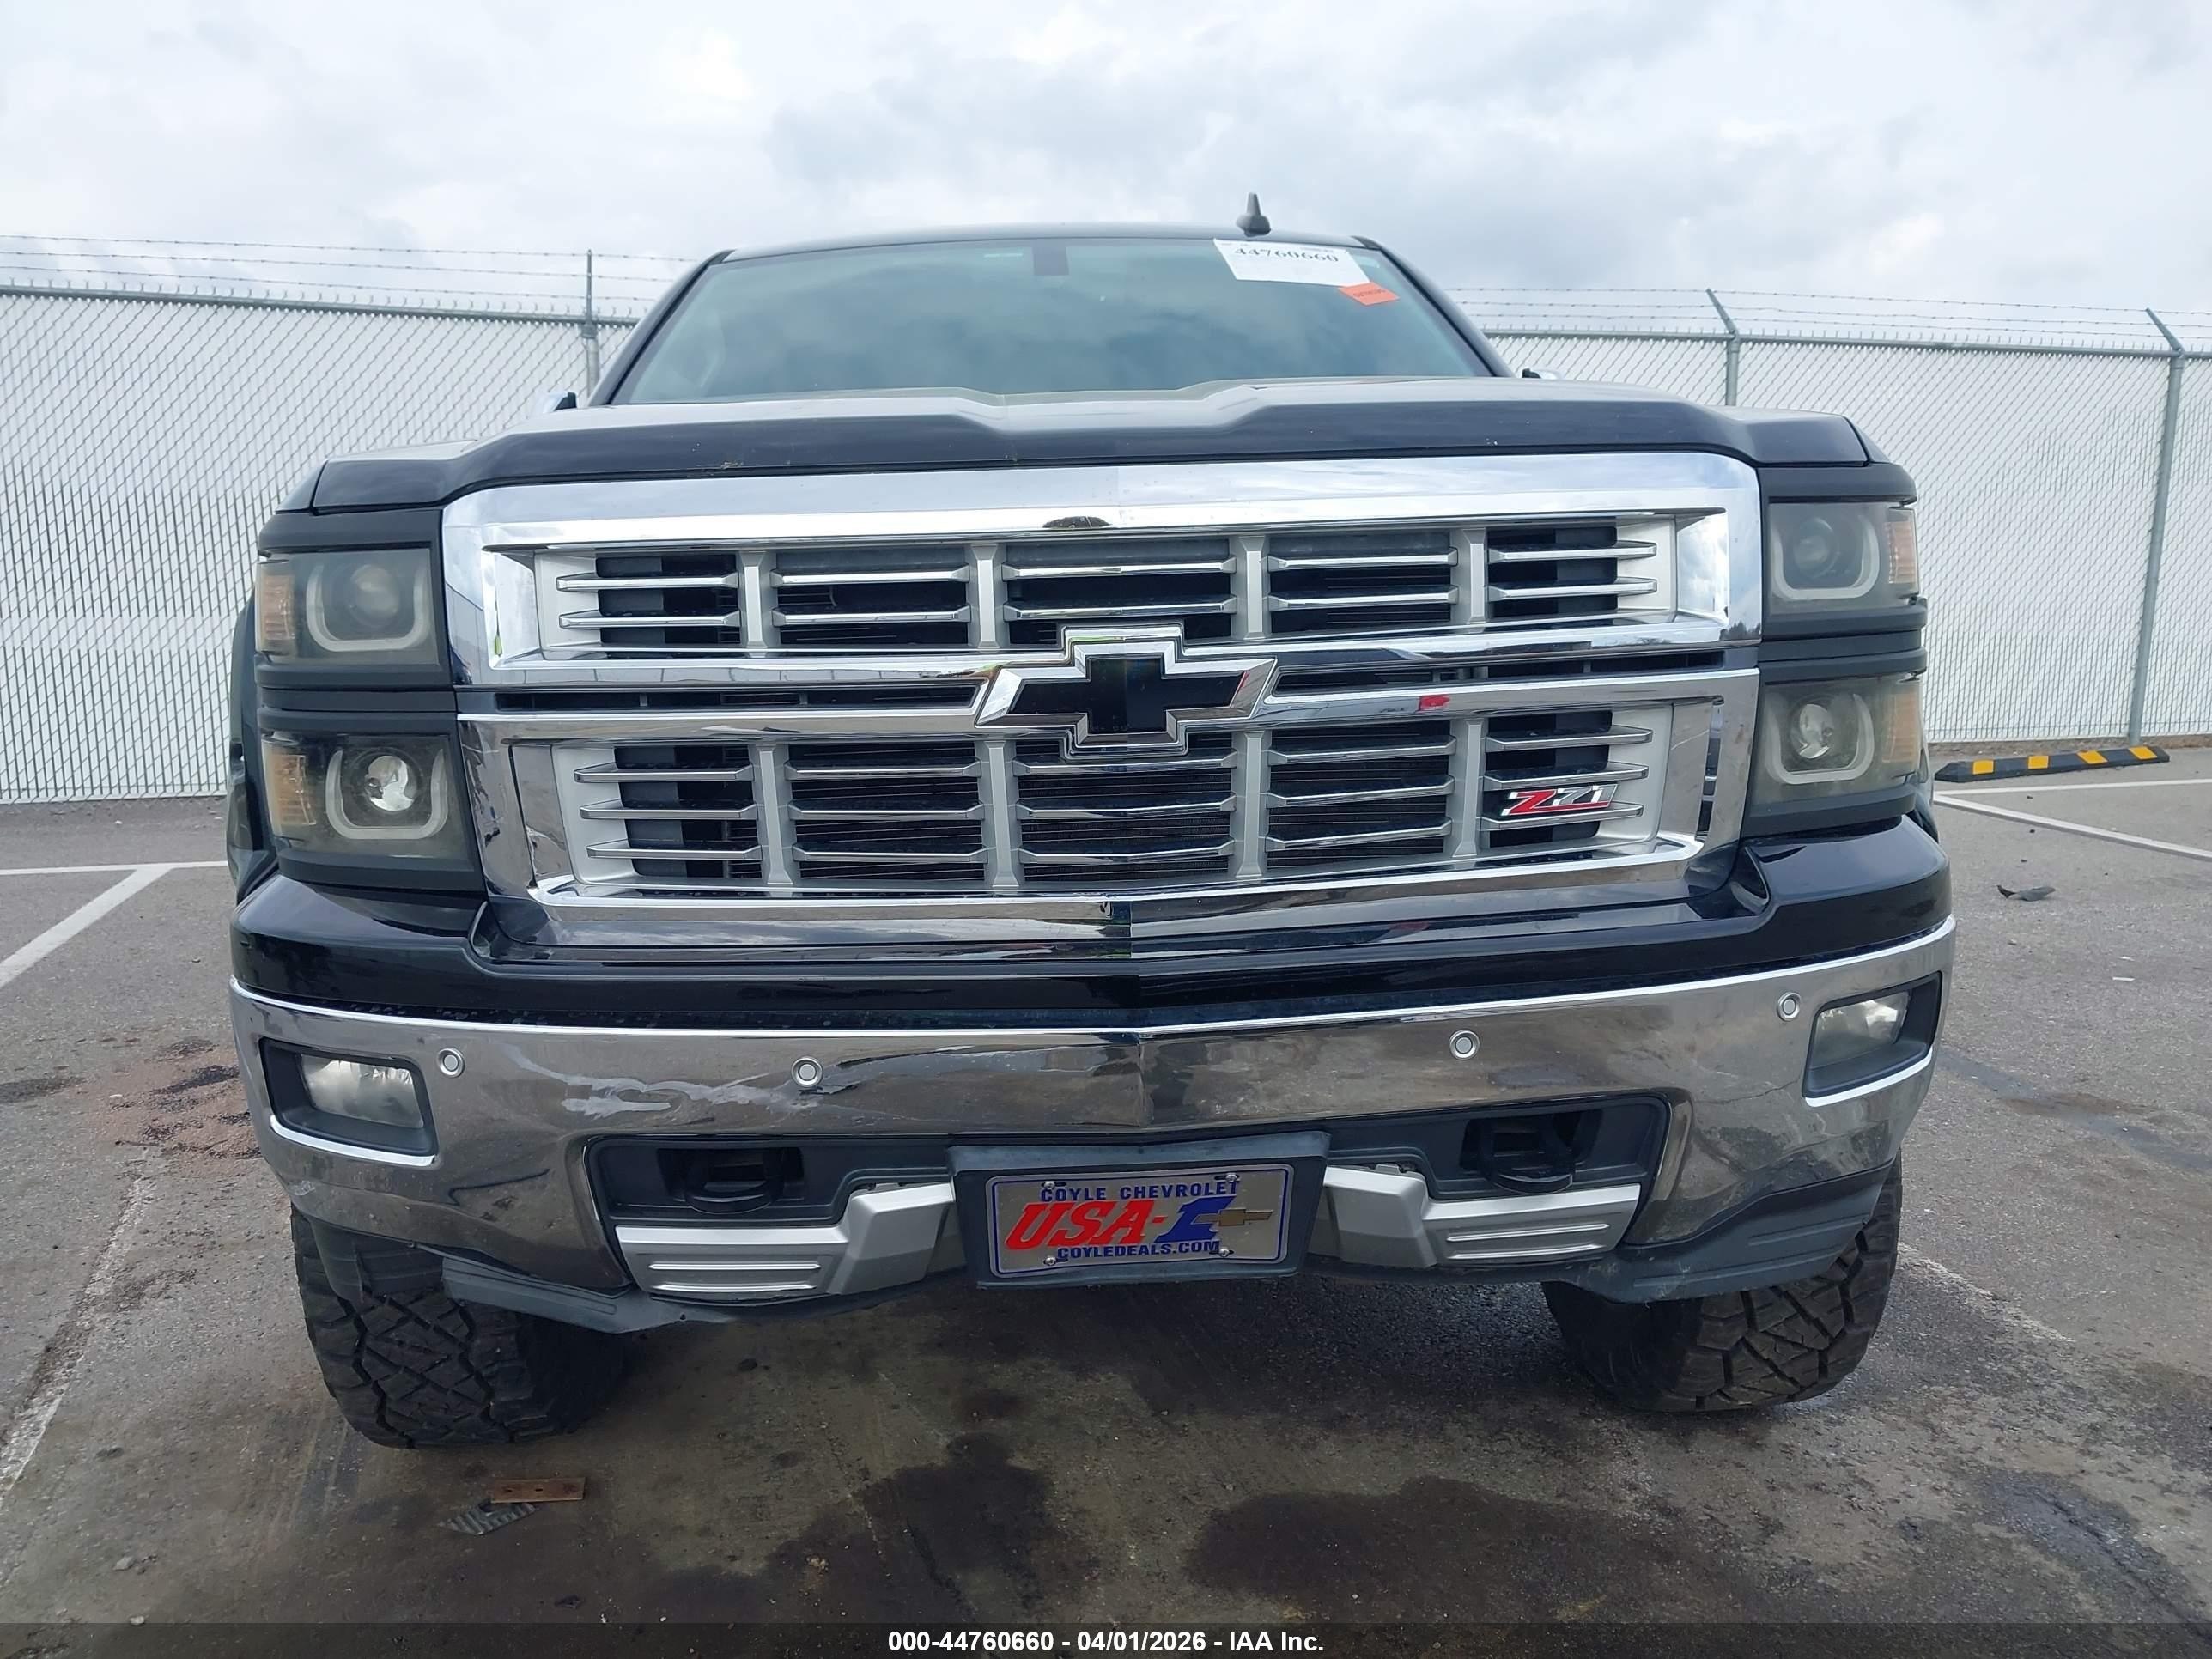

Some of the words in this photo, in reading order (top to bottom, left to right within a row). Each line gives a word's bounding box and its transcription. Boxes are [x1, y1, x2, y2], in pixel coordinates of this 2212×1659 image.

[1501, 783, 1618, 817] Z71
[1041, 1187, 1107, 1202] COYLE
[1120, 1179, 1240, 1200] CHEVROLET
[1057, 1239, 1220, 1260] COYLEDEALS.COM
